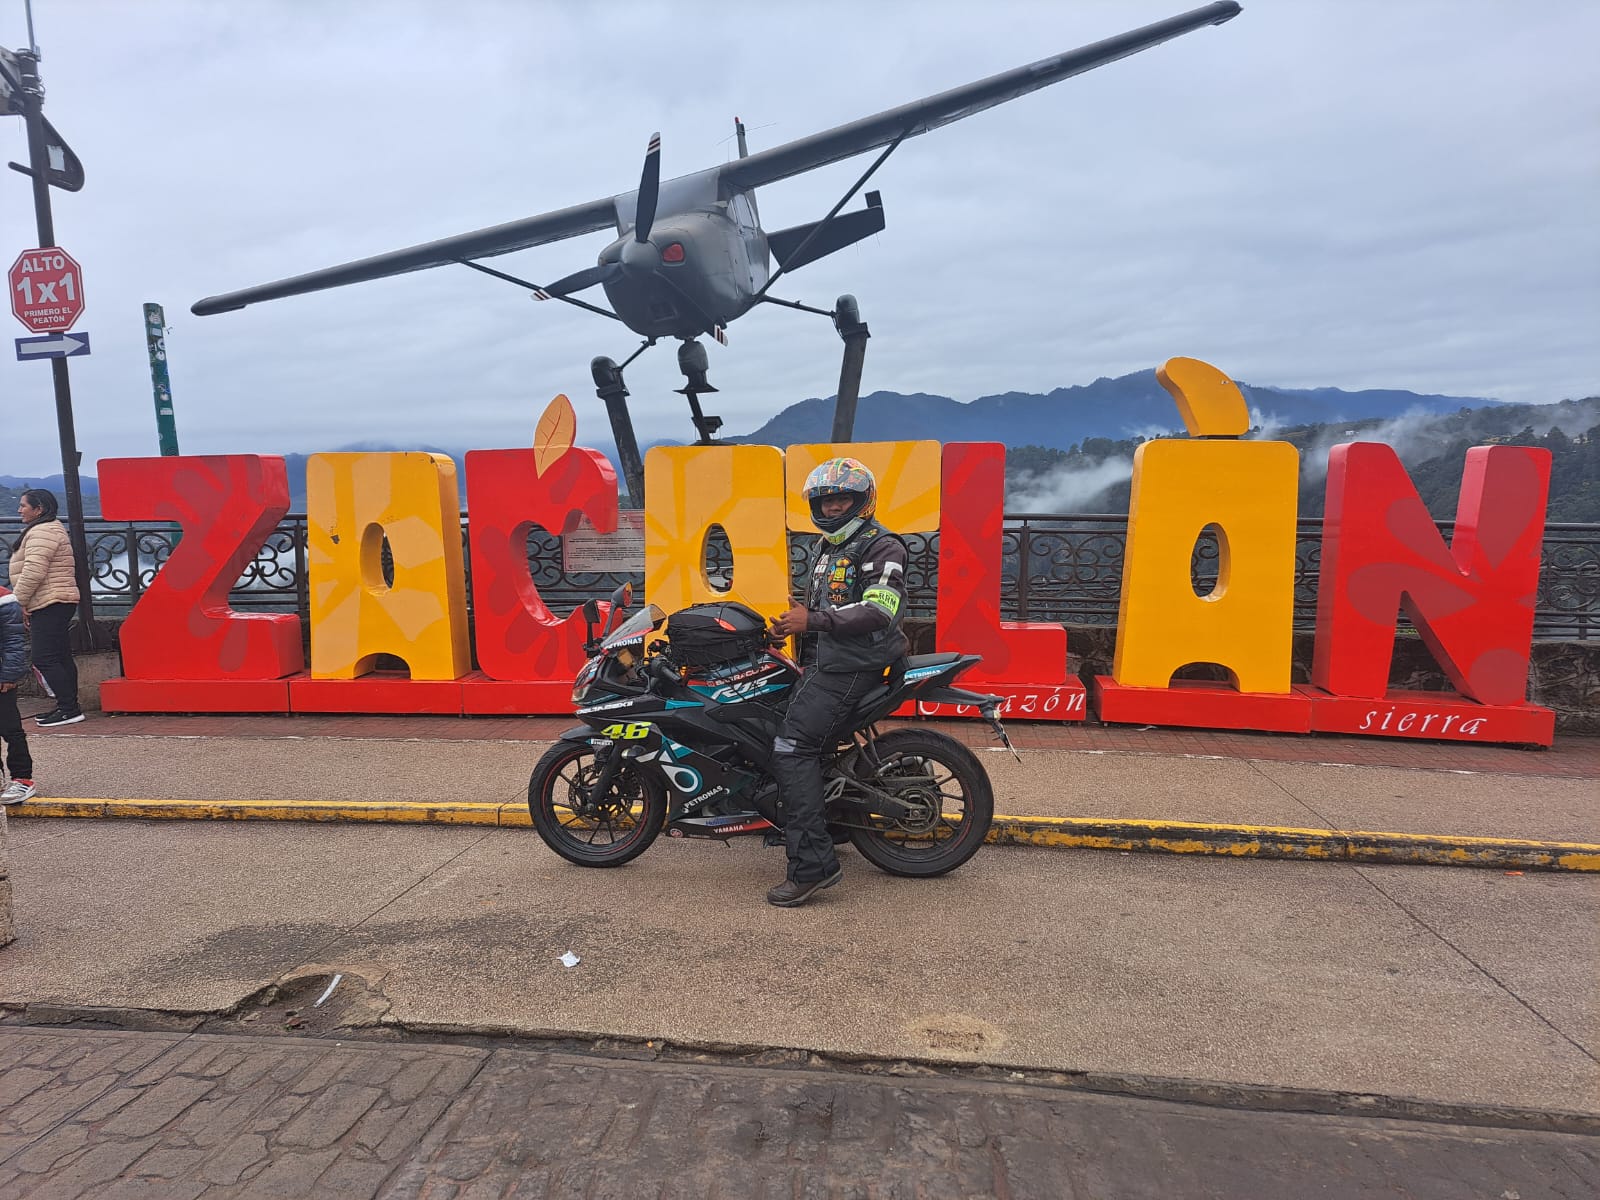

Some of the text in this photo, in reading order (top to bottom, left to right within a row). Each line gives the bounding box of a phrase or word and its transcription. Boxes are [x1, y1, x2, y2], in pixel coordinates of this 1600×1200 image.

[22, 255, 65, 273] ALTO
[17, 272, 75, 305] 1x1
[24, 306, 72, 318] PRIMERO EL
[919, 687, 1085, 716] Coazón
[600, 721, 652, 740] 46
[1359, 705, 1487, 735] sierra
[683, 785, 724, 810] PETRONAS
[713, 824, 744, 835] YAMAHA
